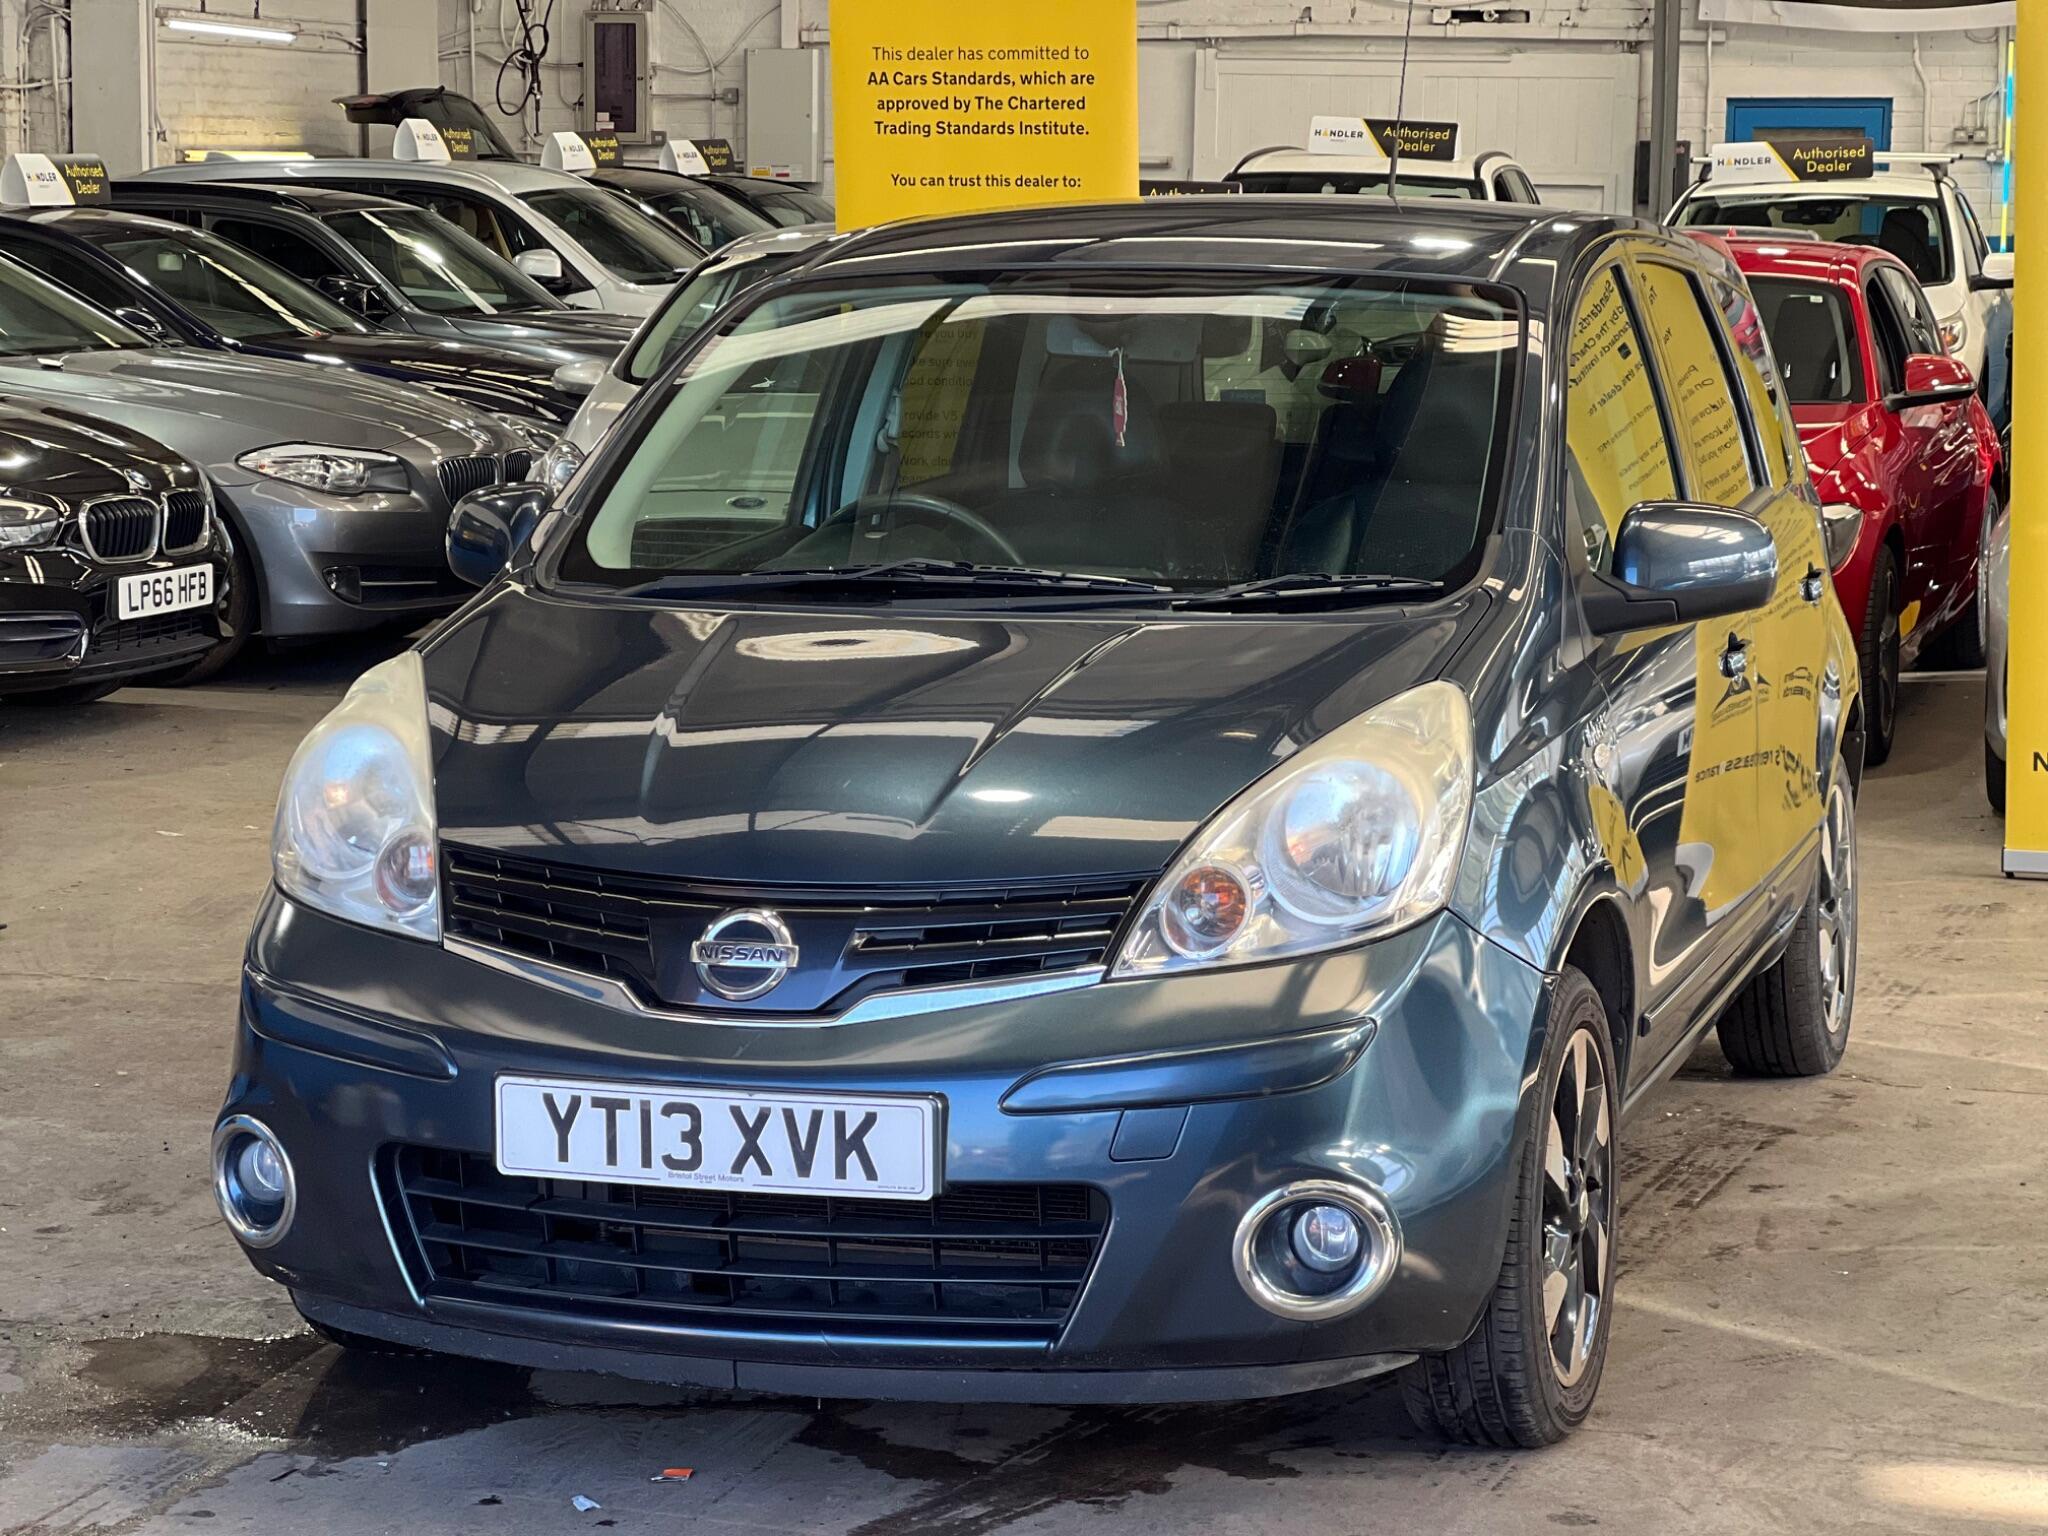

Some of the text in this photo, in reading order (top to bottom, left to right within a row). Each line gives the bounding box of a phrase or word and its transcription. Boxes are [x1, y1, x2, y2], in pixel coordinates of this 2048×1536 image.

[872, 45, 1089, 61] This dealer has committed to
[868, 71, 1094, 87] AA Cars Standards, which are
[877, 96, 1086, 113] approved by The Chartered
[874, 121, 1089, 138] Trading Standards Institute.
[1383, 126, 1450, 140] Authorised
[1793, 144, 1866, 160] Authorised
[64, 161, 105, 178] Authorised
[1806, 160, 1852, 173] Dealer
[75, 179, 100, 194] Dealer
[891, 174, 1081, 188] You can trust this dealer to:
[127, 571, 207, 612] LP66 HFB
[700, 944, 784, 962] NISSAN
[543, 1093, 878, 1182] YT13 XVK
